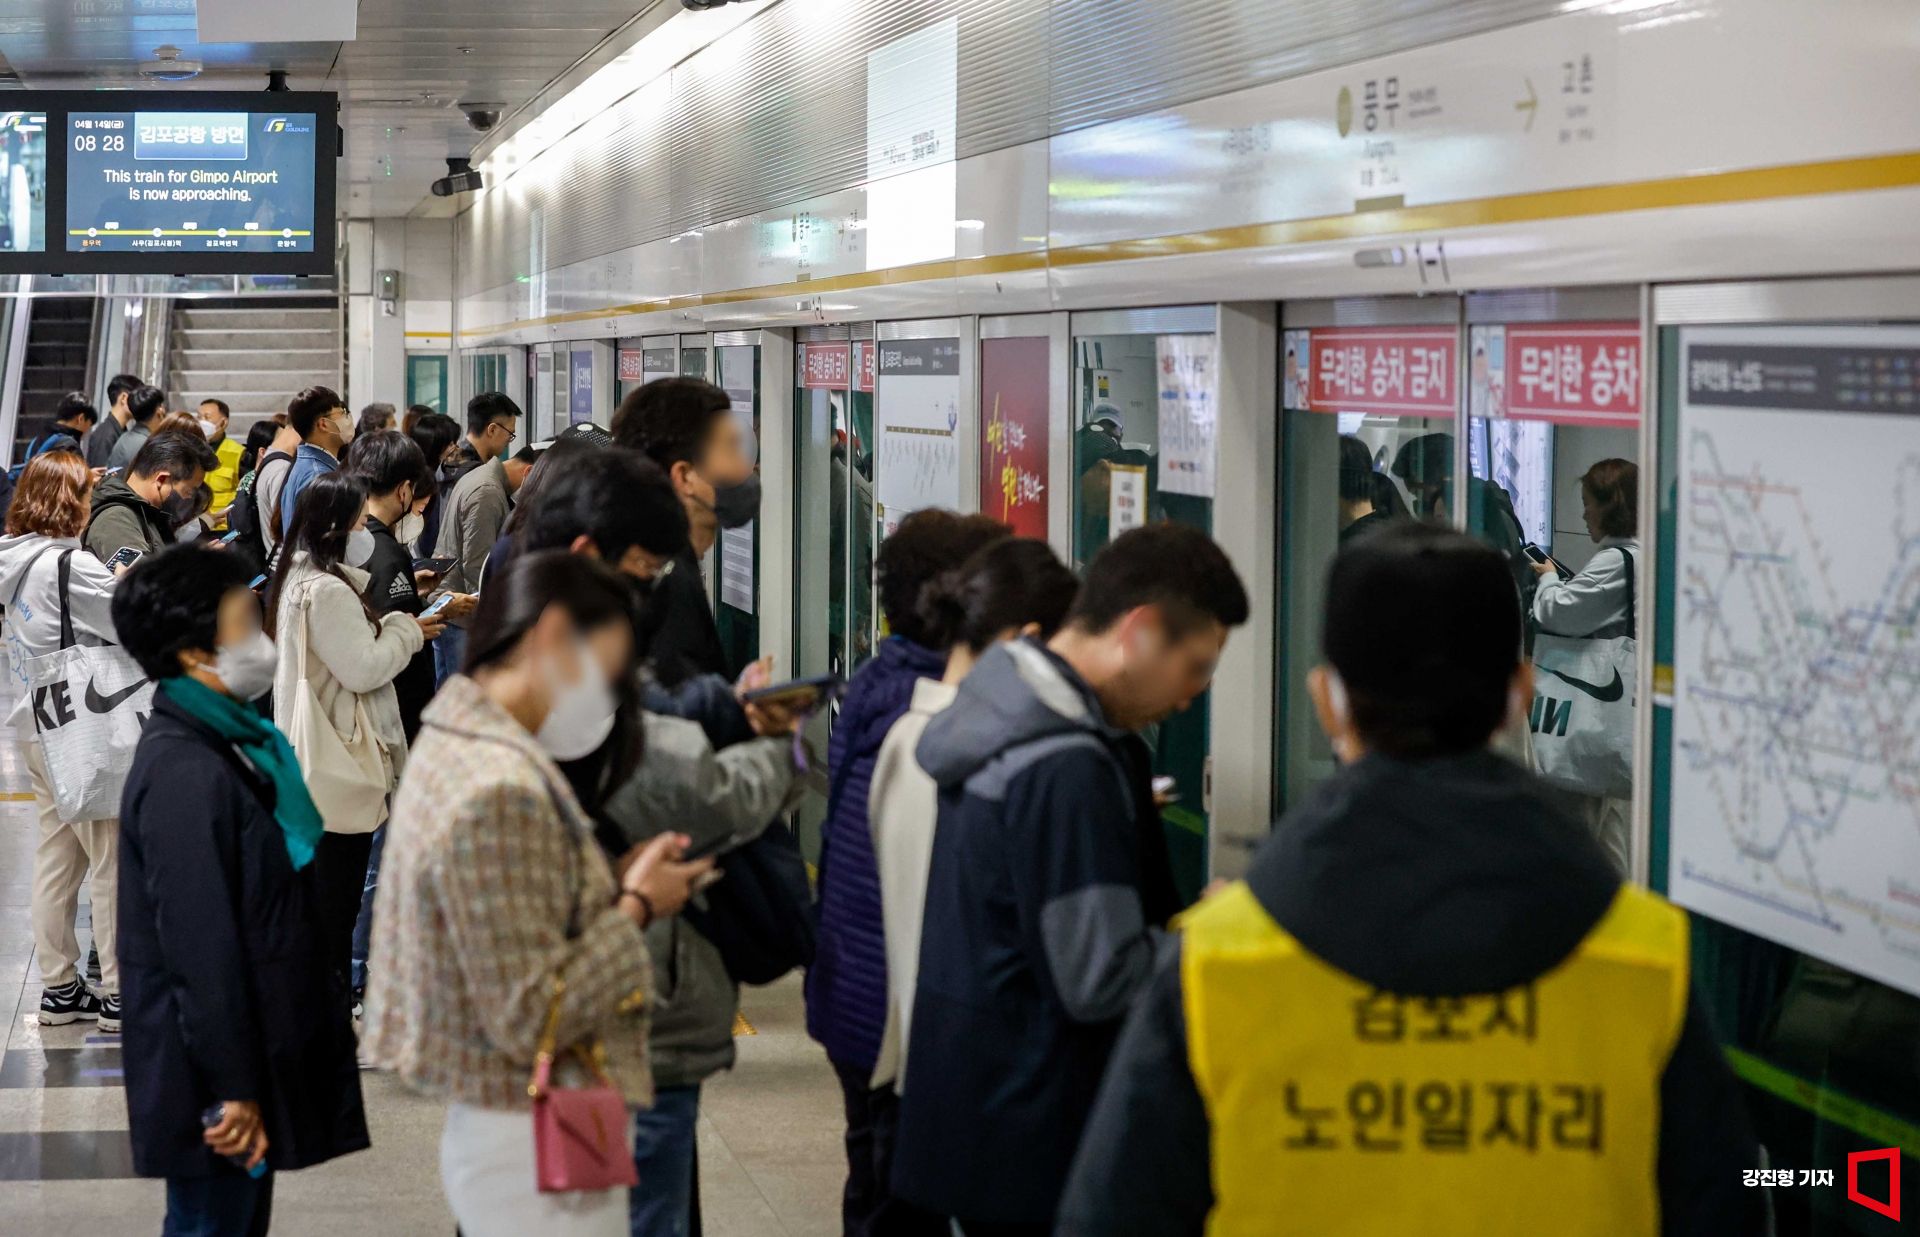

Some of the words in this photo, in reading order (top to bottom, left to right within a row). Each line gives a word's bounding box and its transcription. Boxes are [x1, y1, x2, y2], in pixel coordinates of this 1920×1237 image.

[1363, 77, 1400, 132] 풍무
[74, 120, 93, 129] 04월
[95, 120, 125, 129] 14일(금)
[74, 135, 97, 152] 08
[102, 135, 125, 152] 28
[140, 126, 207, 144] 김포공항
[211, 126, 245, 144] 방면
[104, 169, 131, 183] This
[134, 169, 164, 183] train
[168, 169, 187, 183] for
[190, 170, 229, 185] Gimpo
[232, 170, 278, 185] Airport
[129, 187, 141, 200] is
[143, 189, 168, 200] now
[171, 187, 252, 202] approaching.
[1319, 347, 1367, 397] 무리한
[1371, 348, 1406, 399] 승차
[1410, 347, 1447, 399] 금지
[1519, 345, 1584, 404] 무리한
[1589, 345, 1639, 406] 승차
[1283, 1078, 1605, 1156] 노인일자리
